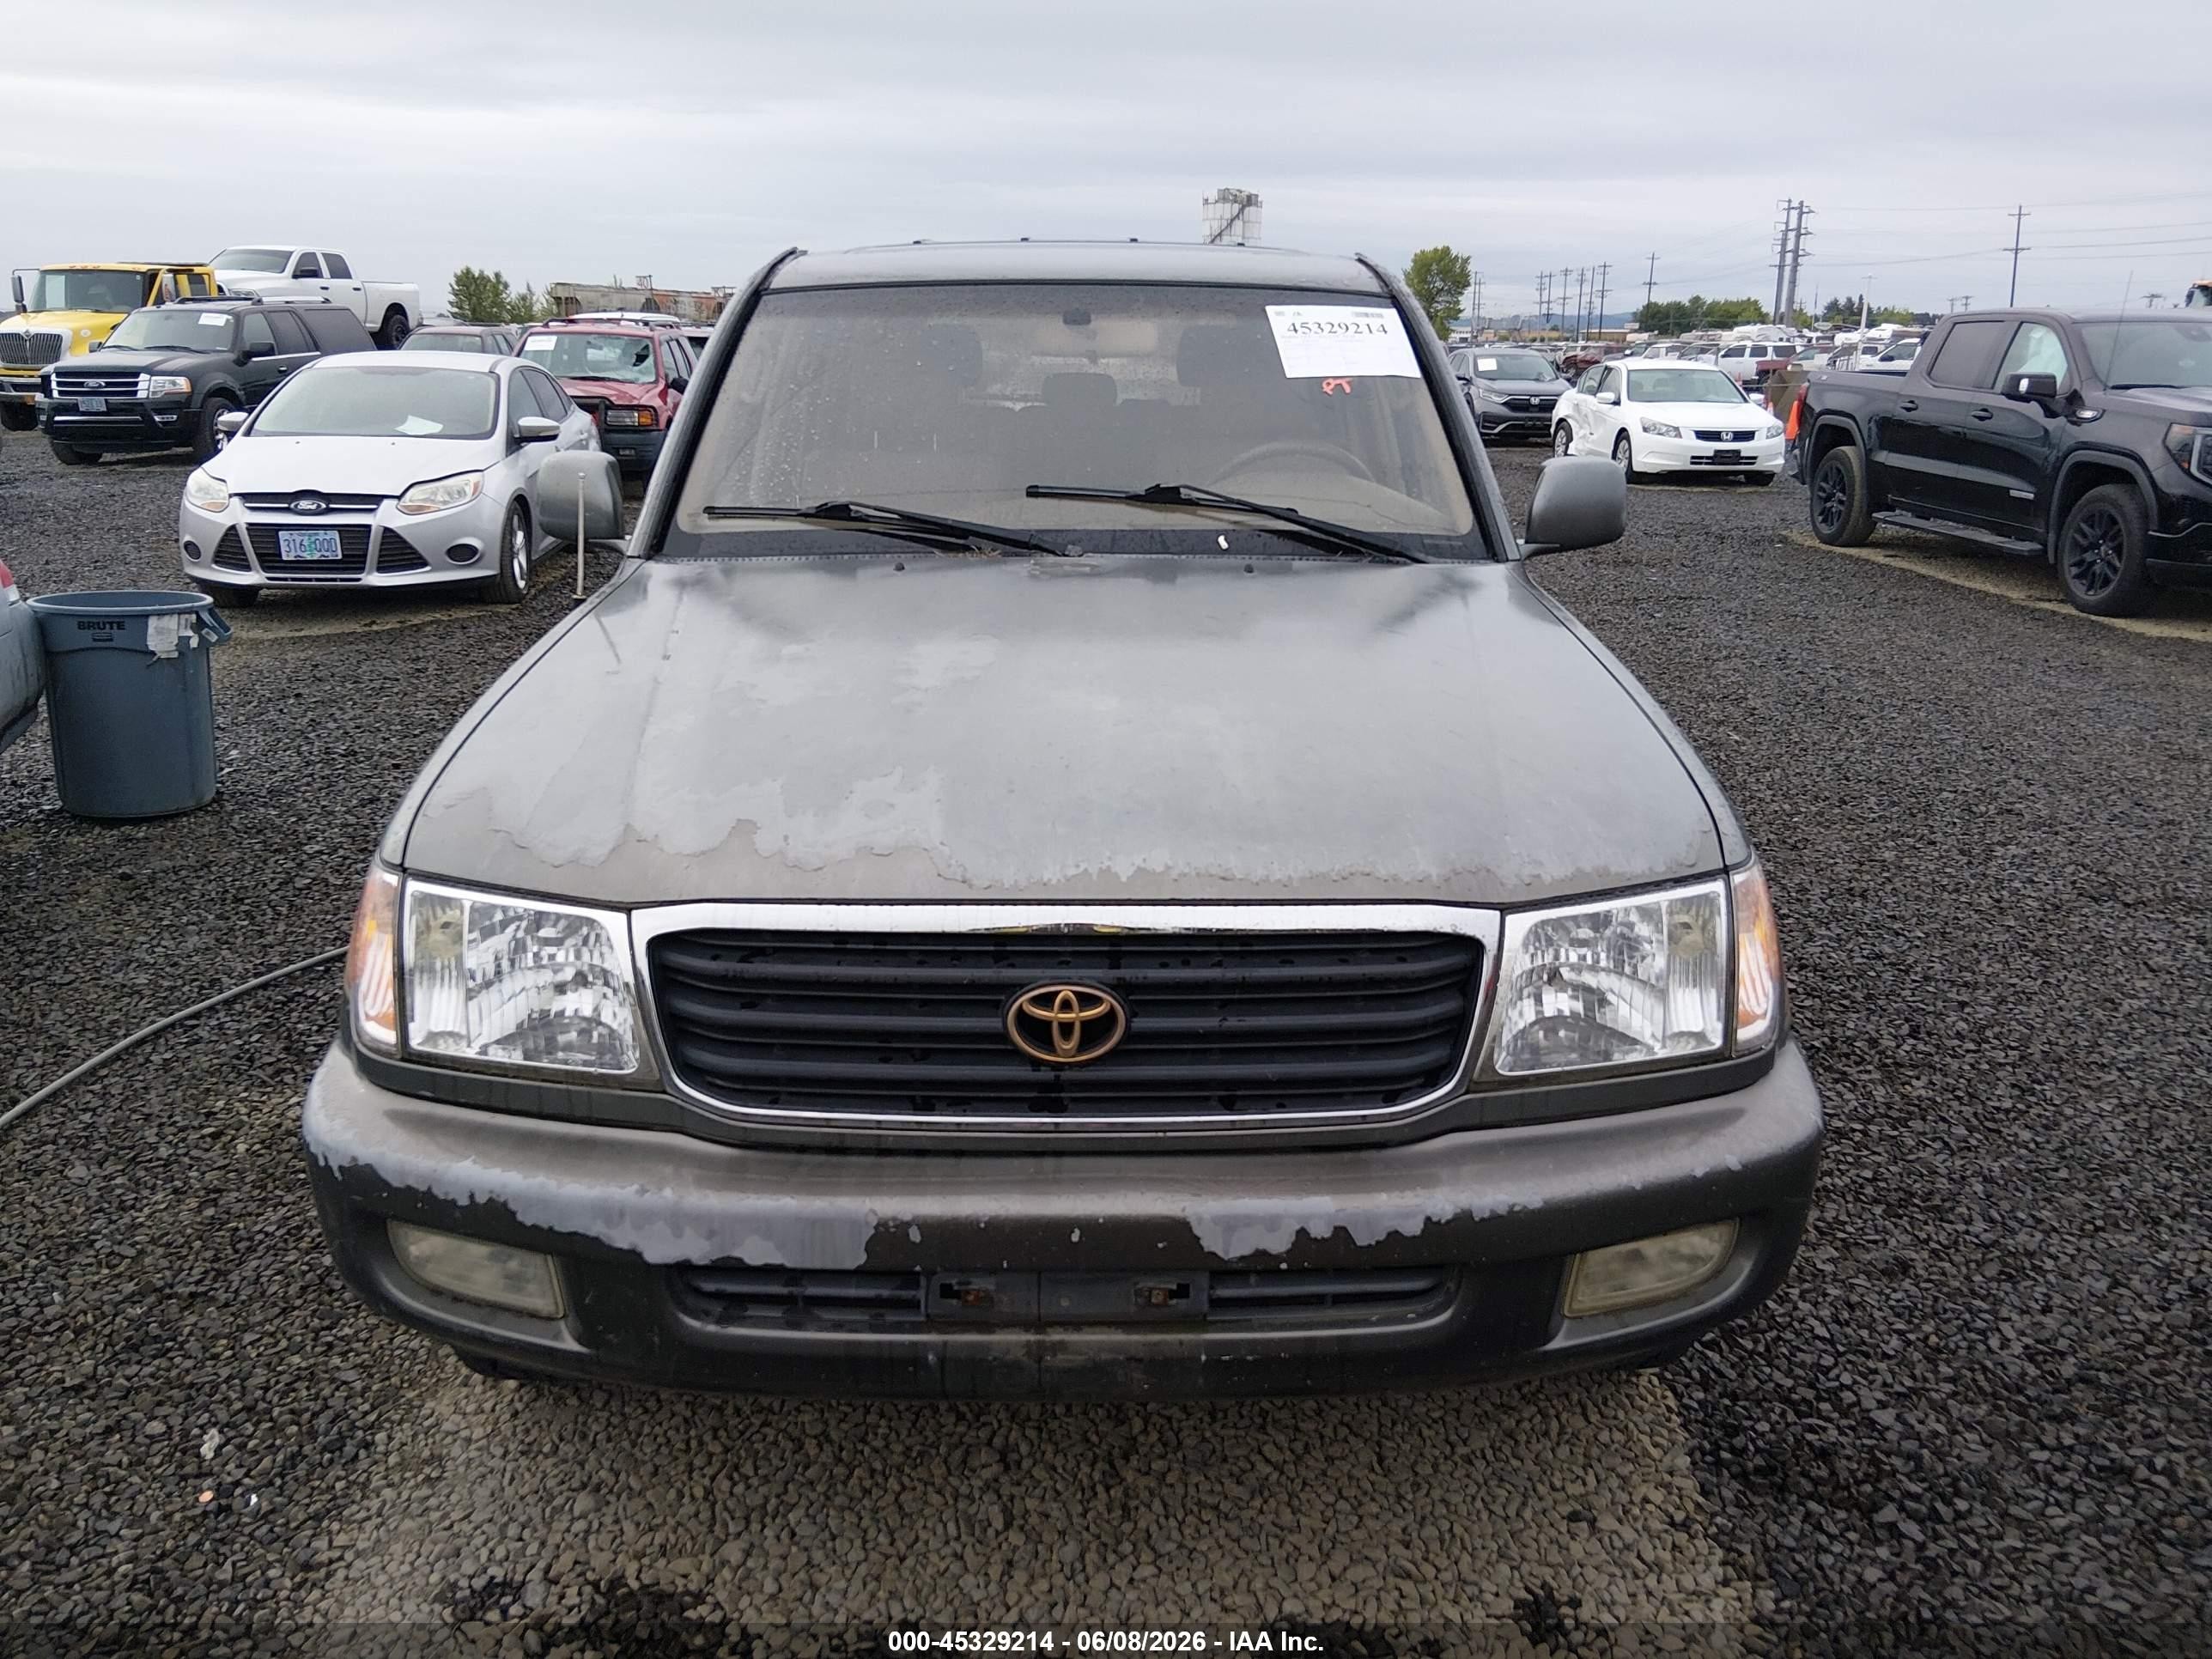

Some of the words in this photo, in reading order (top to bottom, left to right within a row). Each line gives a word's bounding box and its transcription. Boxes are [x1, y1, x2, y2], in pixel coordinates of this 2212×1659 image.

[1287, 321, 1389, 335] 45329214
[283, 538, 307, 553] 316
[77, 620, 126, 631] BRUTE
